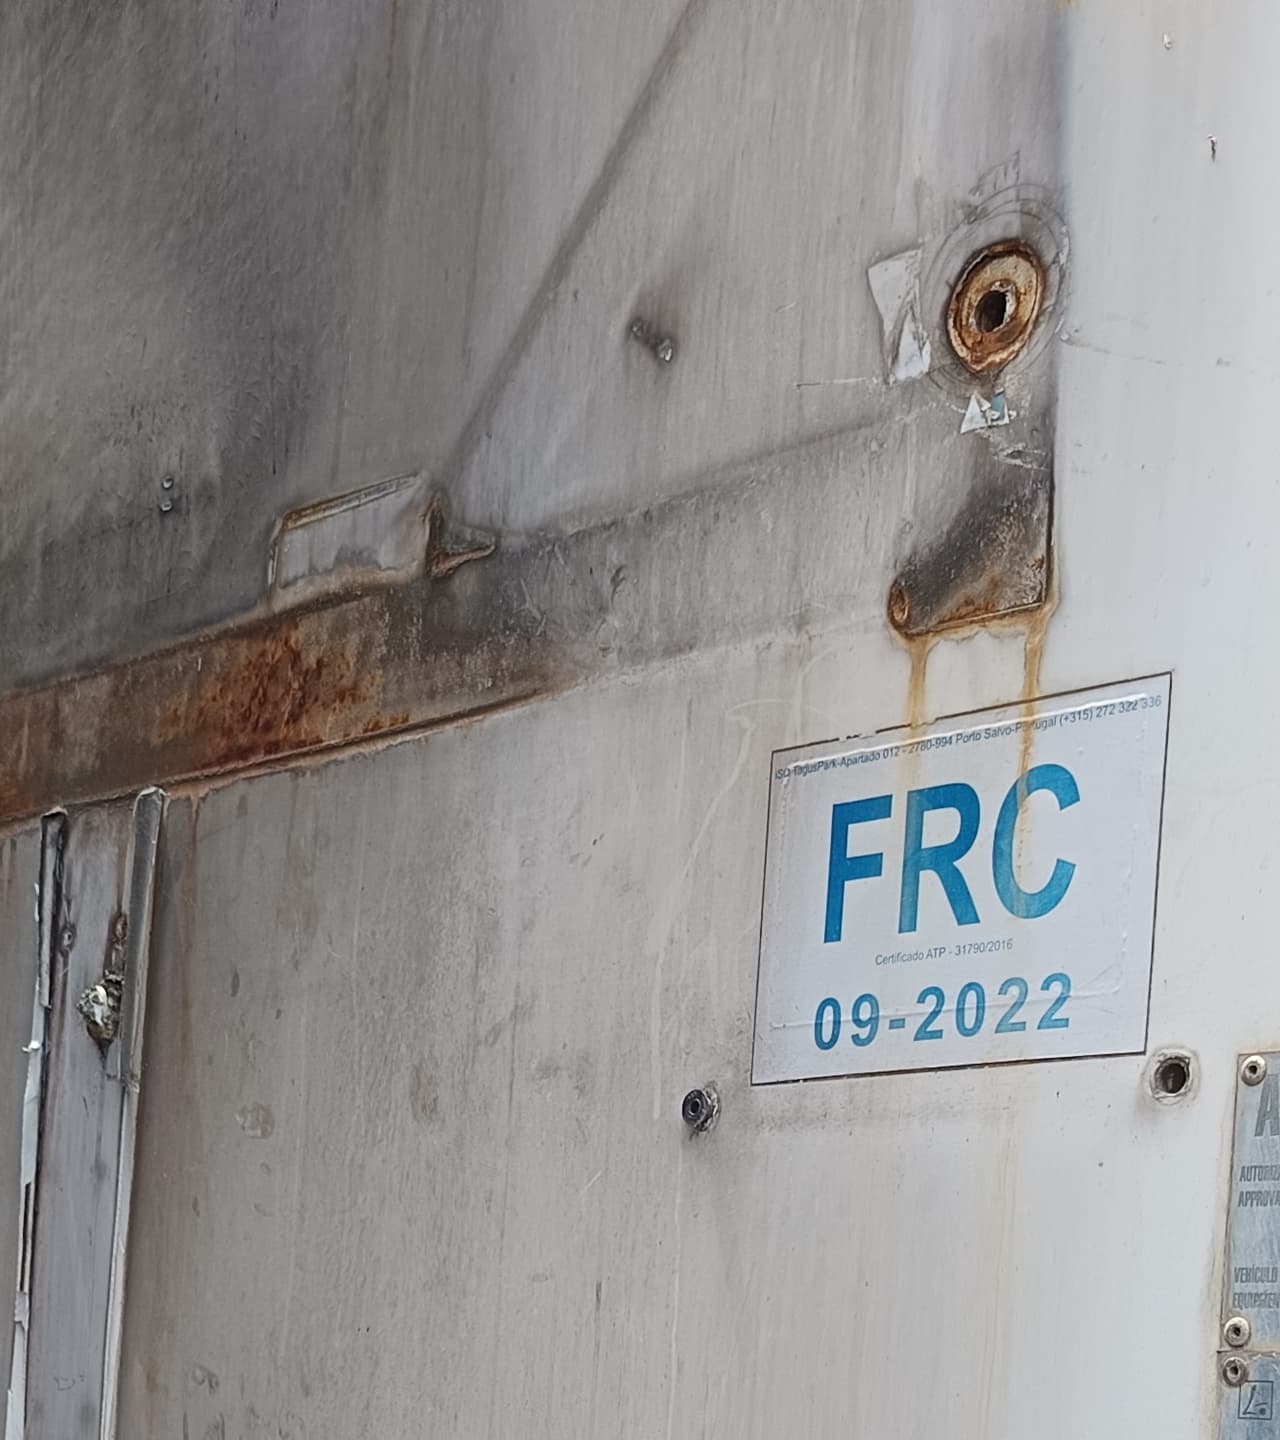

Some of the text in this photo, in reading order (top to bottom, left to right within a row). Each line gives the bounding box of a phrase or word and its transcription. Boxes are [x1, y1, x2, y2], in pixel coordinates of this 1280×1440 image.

[882, 747, 901, 760] 012
[984, 716, 1057, 740] Salvo-Potugal
[1095, 703, 1115, 718] 272
[1117, 699, 1138, 714] 322
[823, 763, 1081, 944] FRC
[875, 949, 924, 966] Certificado
[926, 946, 946, 960] ATP
[955, 938, 1014, 957] 31790/2016
[814, 972, 1072, 1051] 09-2022
